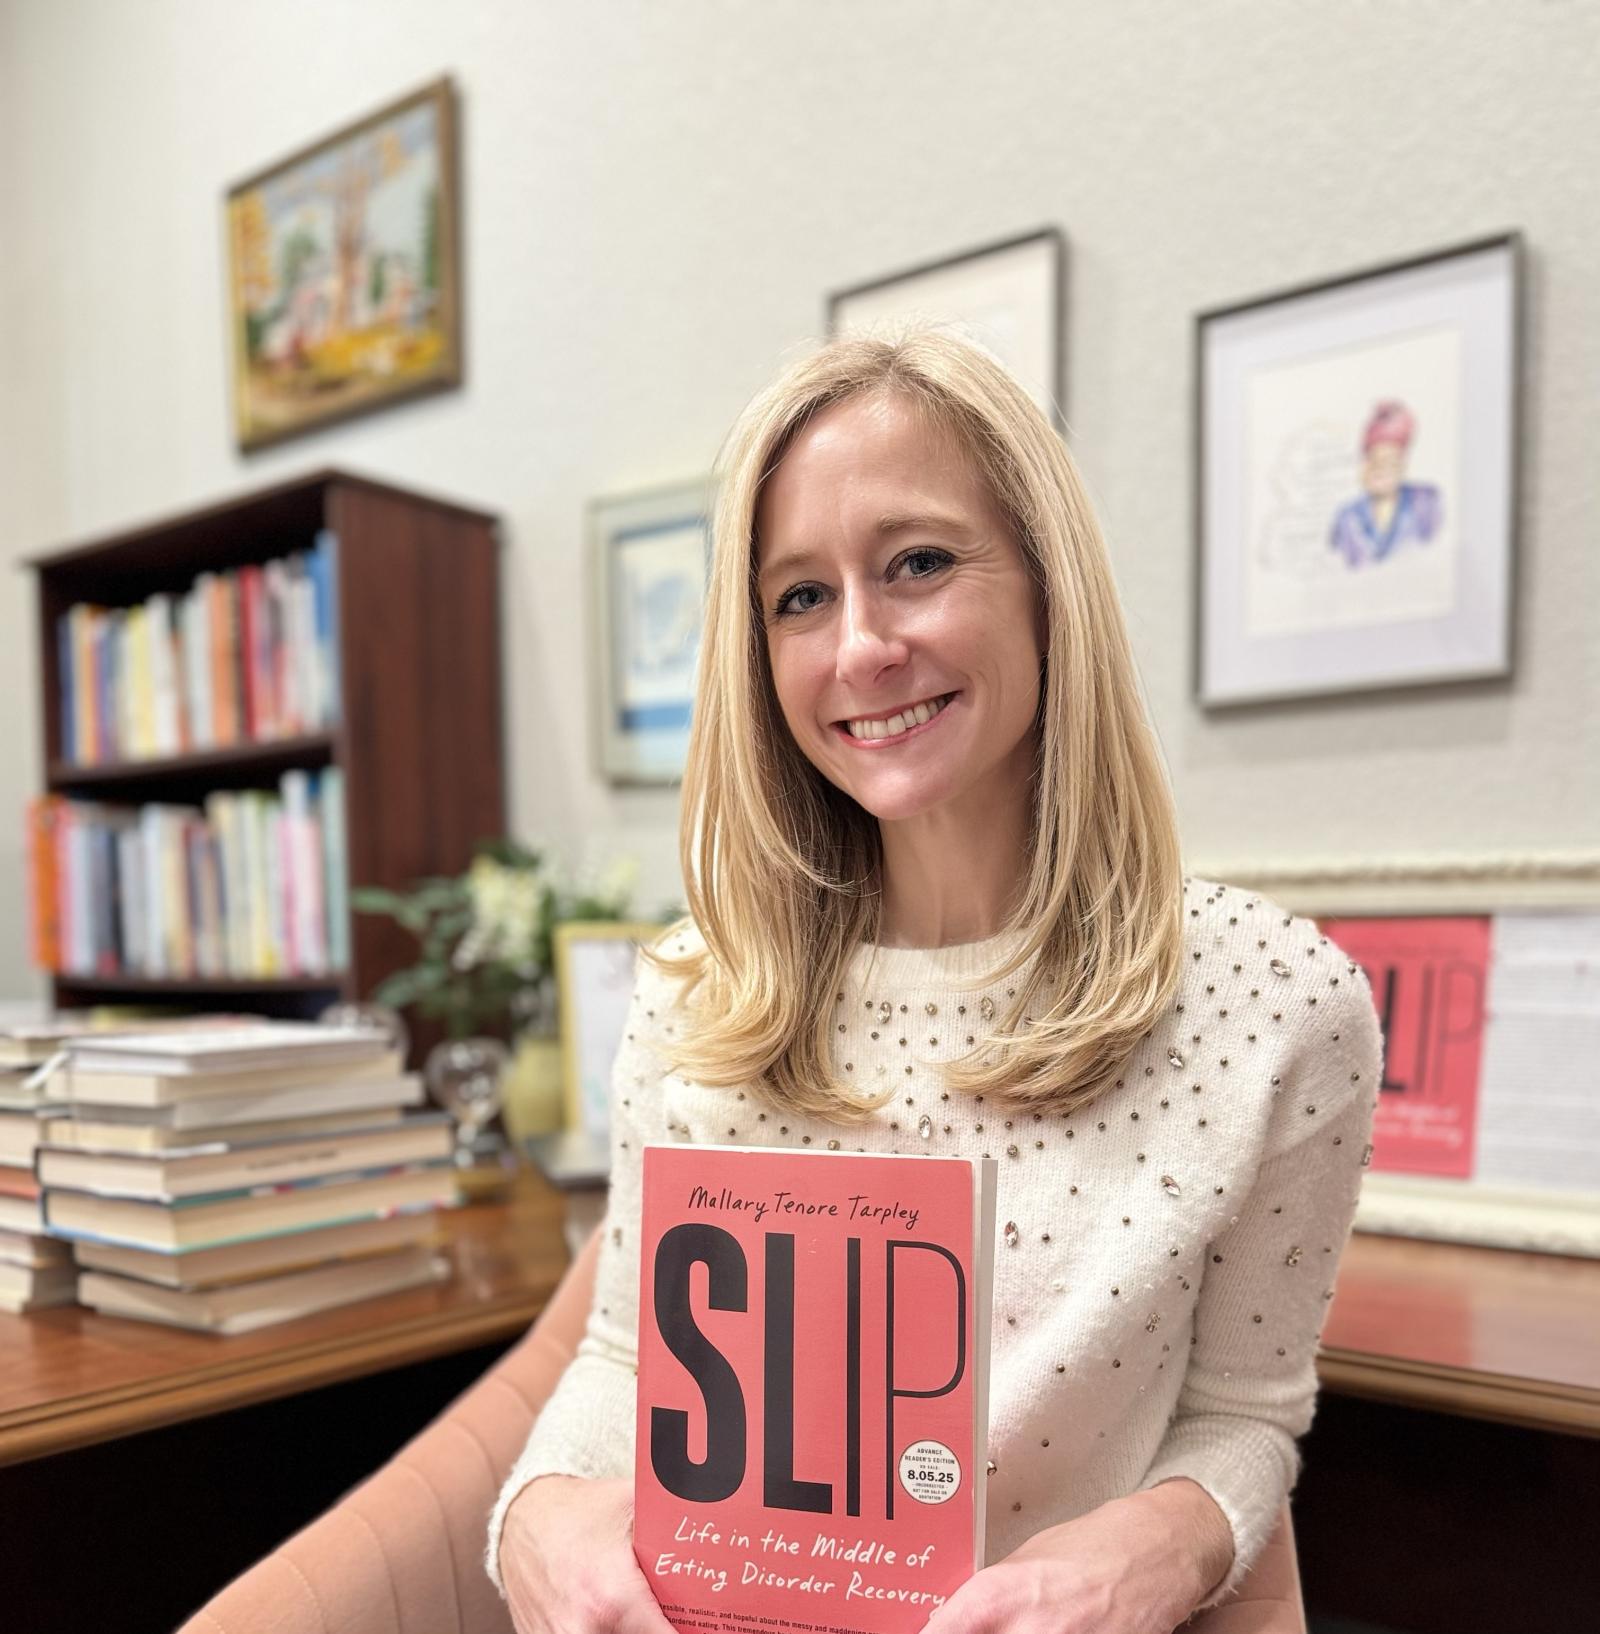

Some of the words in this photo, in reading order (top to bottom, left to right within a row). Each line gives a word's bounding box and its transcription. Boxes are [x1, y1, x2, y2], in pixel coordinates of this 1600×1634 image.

[1362, 961, 1482, 1098] LIP
[687, 1185, 768, 1223] Mallary
[774, 1191, 839, 1217] Tenore
[848, 1194, 920, 1230] Tarpley
[650, 1222, 966, 1520] SLIP
[904, 1455, 931, 1463] READER'S
[907, 1469, 954, 1483] 8.05.25
[674, 1516, 721, 1544] Life
[729, 1528, 750, 1549] in
[760, 1529, 800, 1555] the
[811, 1533, 897, 1565] Middle
[906, 1545, 935, 1568] of
[655, 1553, 728, 1592] Eating
[741, 1561, 835, 1594] Disorder
[846, 1571, 947, 1619] Recovery
[688, 1607, 718, 1618] realistic,
[733, 1612, 758, 1623] hopeful
[759, 1617, 778, 1626] about
[779, 1619, 790, 1627] the
[791, 1622, 813, 1632] messy
[698, 1622, 721, 1631] eating.
[722, 1624, 736, 1632] This
